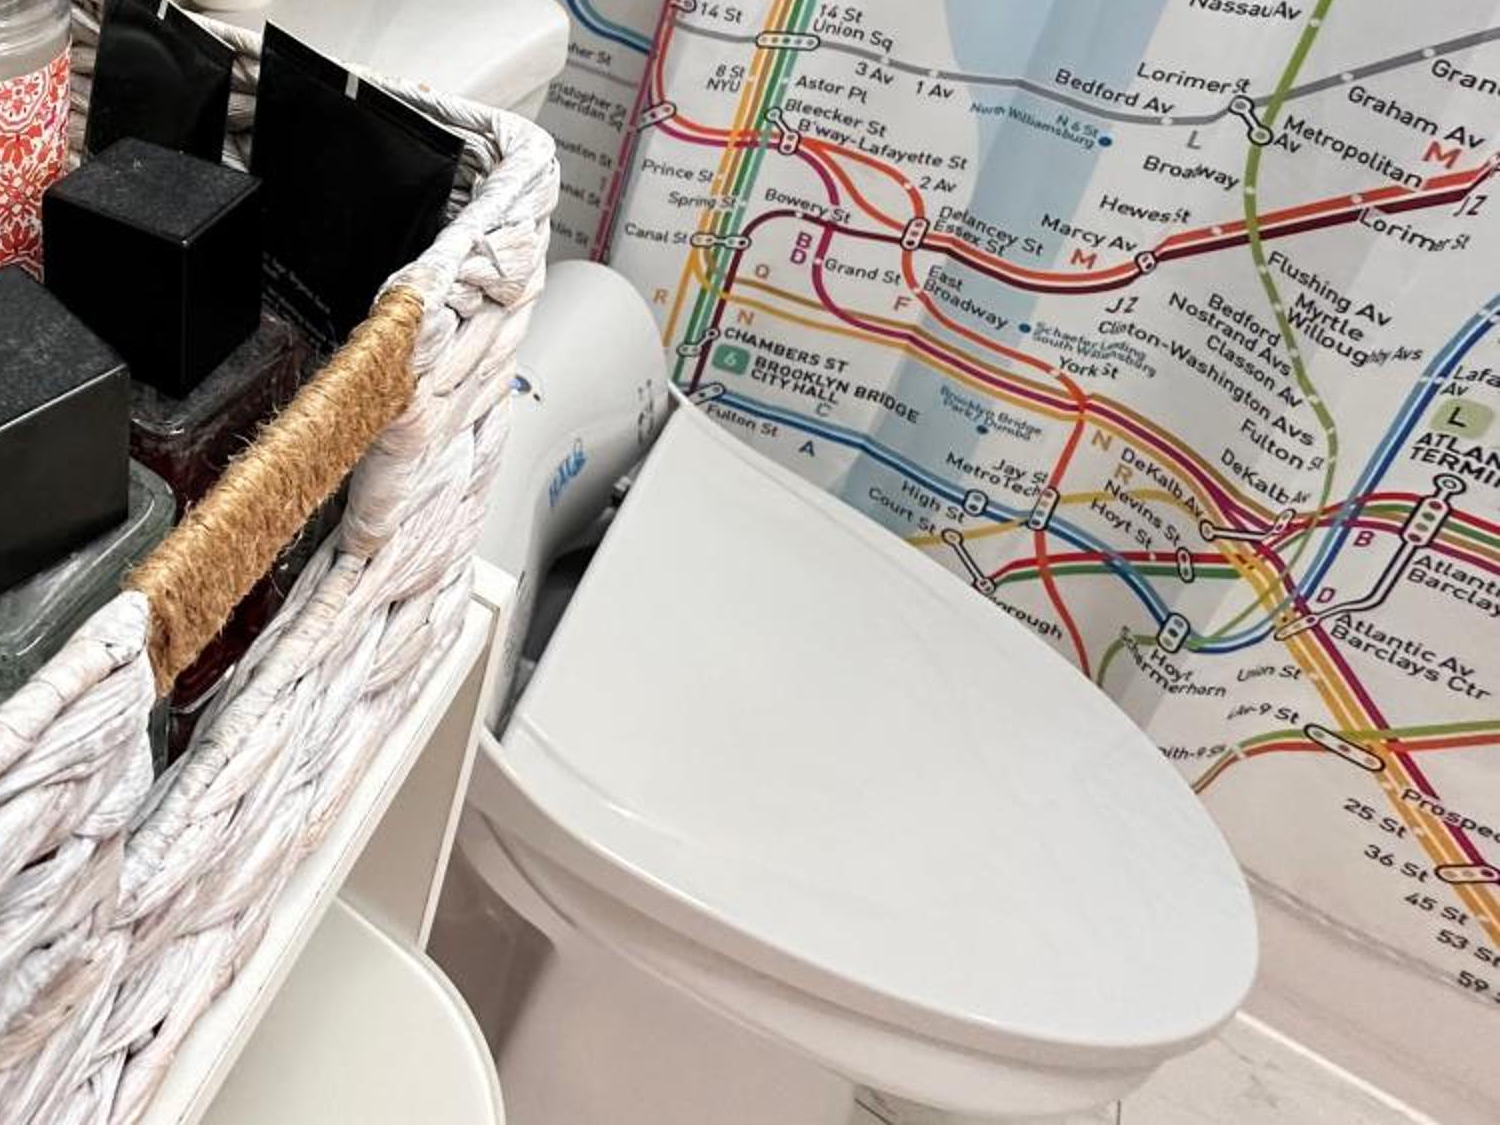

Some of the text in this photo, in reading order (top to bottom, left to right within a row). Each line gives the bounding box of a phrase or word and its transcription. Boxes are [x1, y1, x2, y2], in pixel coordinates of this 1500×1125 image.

[1273, 1, 1303, 21] Av
[812, 19, 894, 53] Union Sq
[706, 77, 740, 94] NYU
[1055, 68, 1175, 115] Bedford Av
[1137, 62, 1229, 94] Lorimer
[785, 98, 887, 139] Bleecker St
[970, 103, 1096, 150] North Williamsburg
[1347, 86, 1486, 150] Graham Av
[947, 154, 968, 172] St
[1283, 115, 1423, 191] Metropolitan
[765, 187, 851, 225] Bowery St
[624, 223, 688, 245] Canal St
[939, 205, 1044, 257] Delancey St
[1040, 213, 1138, 253] Marcy Av
[825, 258, 901, 287] Grand St
[1268, 251, 1393, 327] Flushing Av
[923, 279, 1009, 330] Broadway
[1207, 293, 1281, 348] Bedford
[1295, 292, 1364, 342] Myrtle
[724, 326, 849, 373] CHAMBERS ST
[1169, 292, 1293, 377] Nostrand Avs
[751, 369, 840, 405] CITY HALL
[754, 355, 921, 425] BROOKLYN BRIDGE
[1206, 334, 1303, 408] Classon Av
[946, 450, 1041, 495] MetroTech
[1220, 449, 1290, 505] DeKalb
[901, 479, 966, 523] High St
[1103, 480, 1182, 544] Nevins St
[1330, 625, 1491, 700] Barclays Ctr
[1334, 613, 1476, 677] Atlantic Av
[1343, 797, 1408, 840] 25 St
[1363, 844, 1428, 883] 36 St
[1404, 892, 1470, 926] 45 St
[1435, 929, 1500, 969] 53 St
